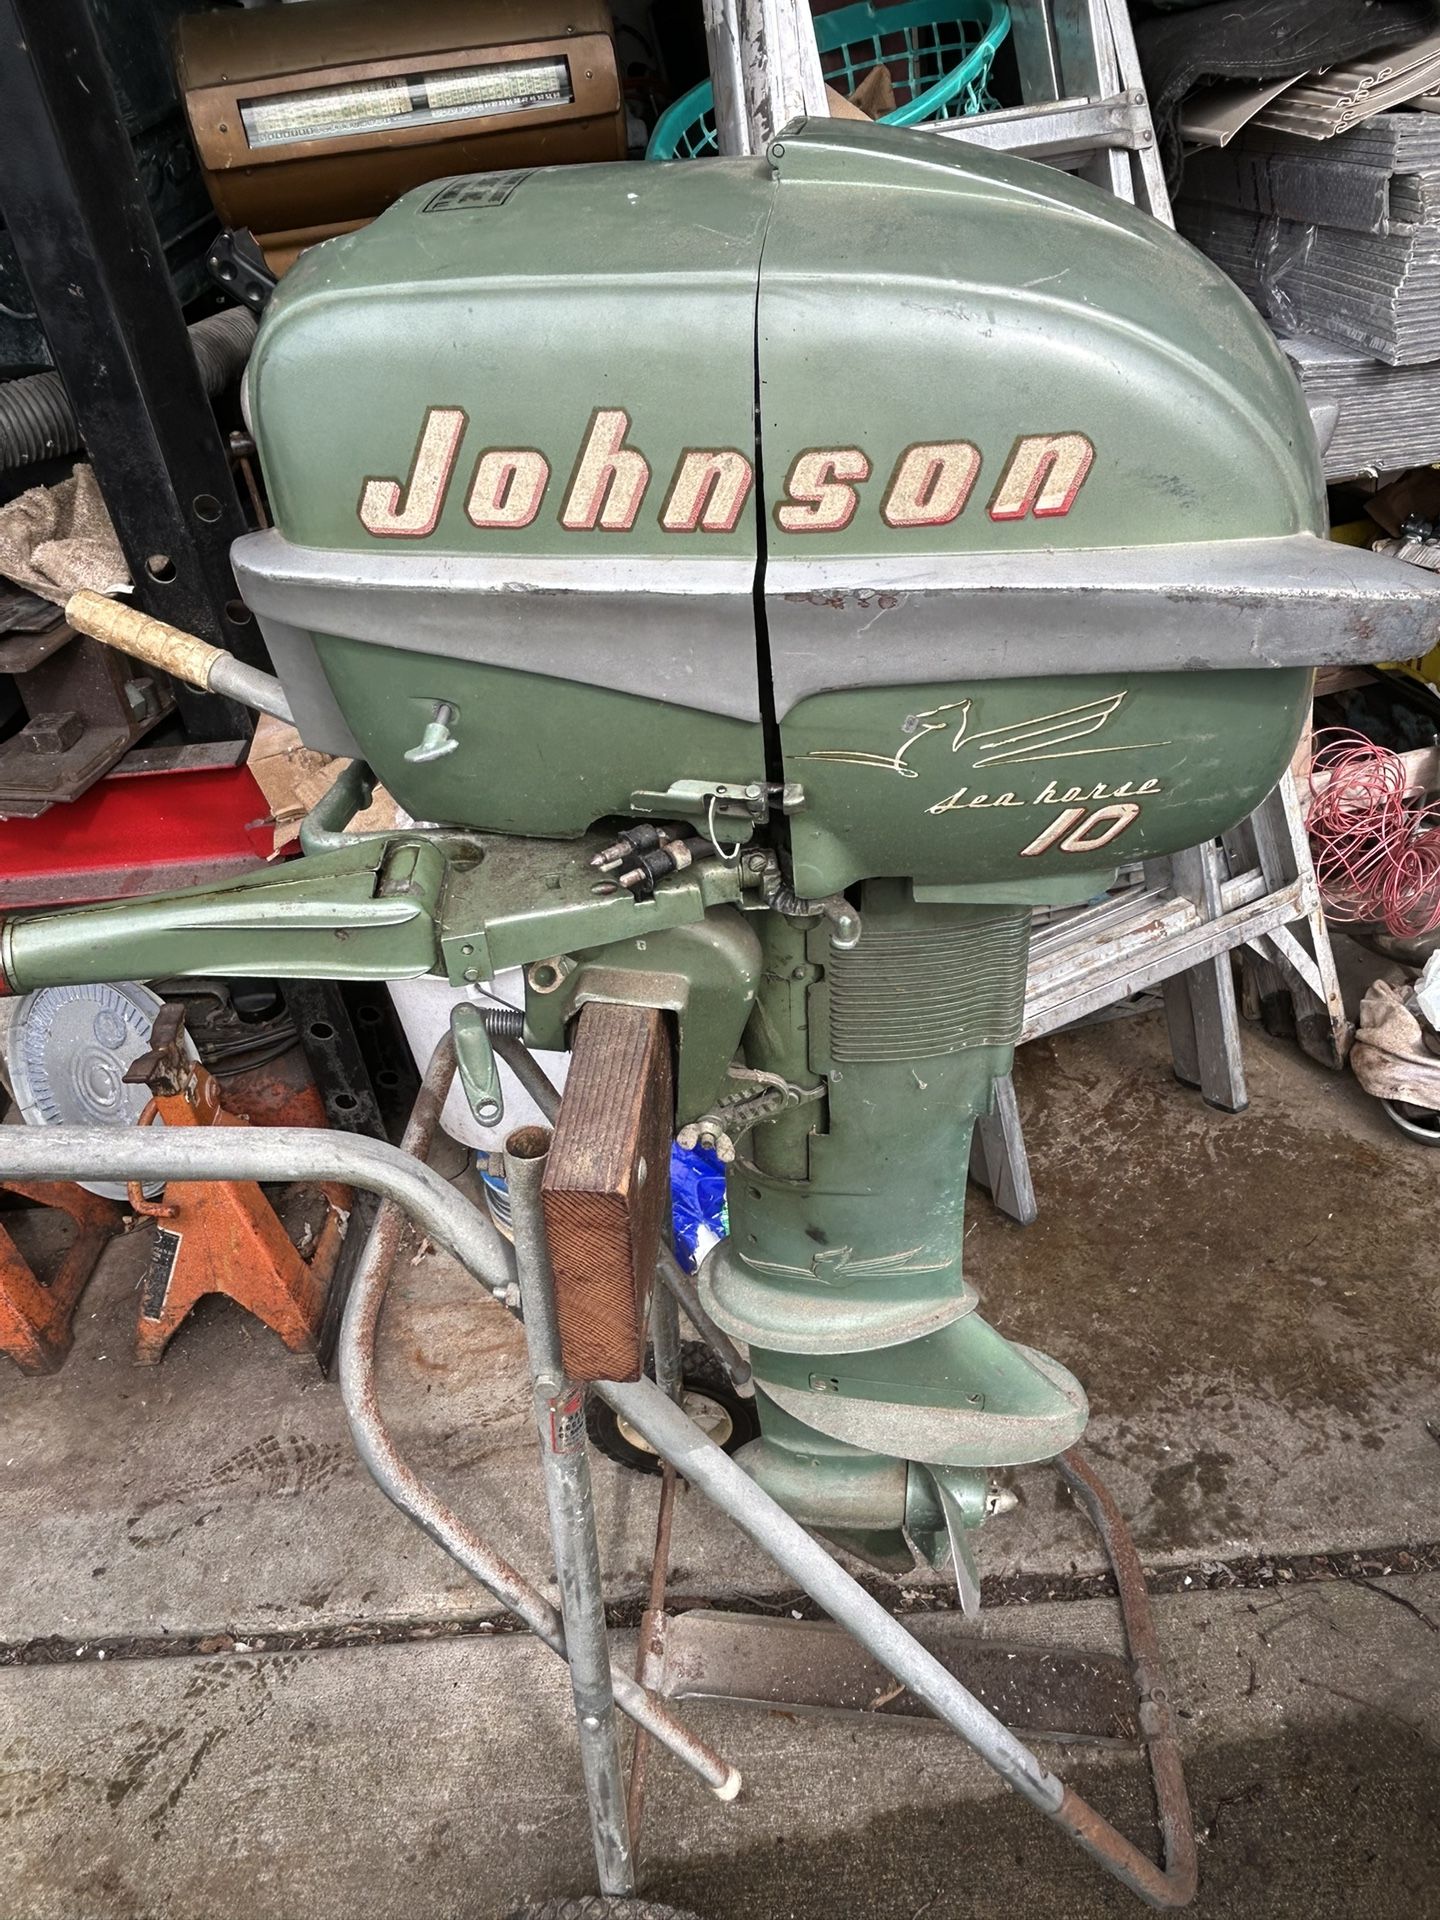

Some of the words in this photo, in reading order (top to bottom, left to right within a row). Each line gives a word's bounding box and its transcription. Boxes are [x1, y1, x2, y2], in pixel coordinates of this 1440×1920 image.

[356, 406, 1096, 537] Johnson
[924, 787, 1025, 815] sea
[1033, 778, 1162, 805] horse
[1018, 803, 1141, 858] 10
